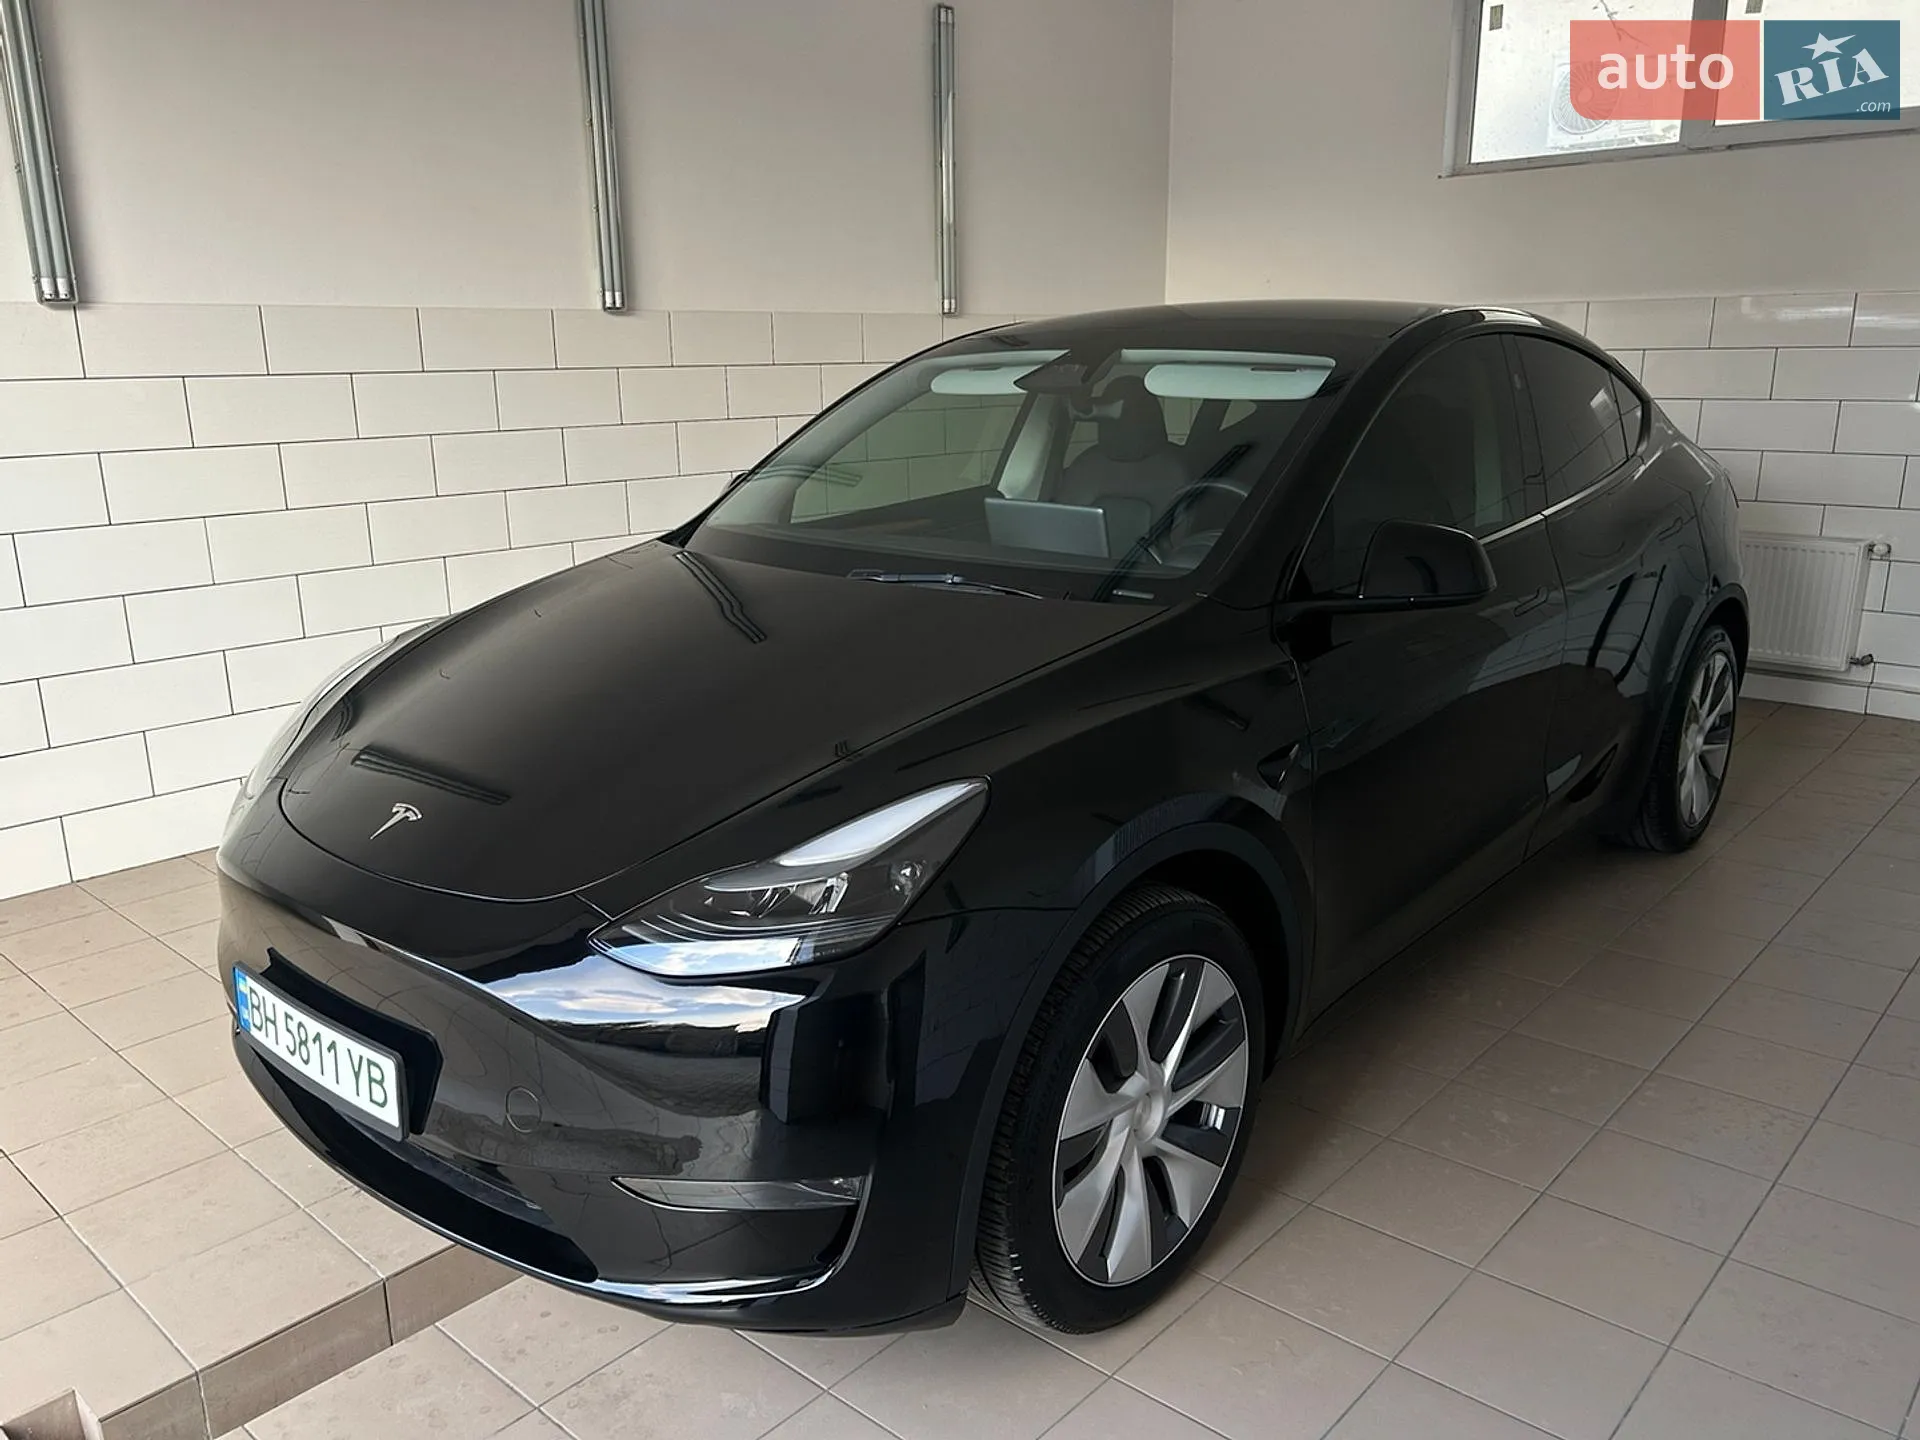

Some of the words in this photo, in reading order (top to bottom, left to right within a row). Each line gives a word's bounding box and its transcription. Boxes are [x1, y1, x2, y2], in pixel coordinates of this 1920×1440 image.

[249, 987, 279, 1045] BH
[284, 1011, 339, 1085] 5811
[347, 1047, 388, 1108] YB
